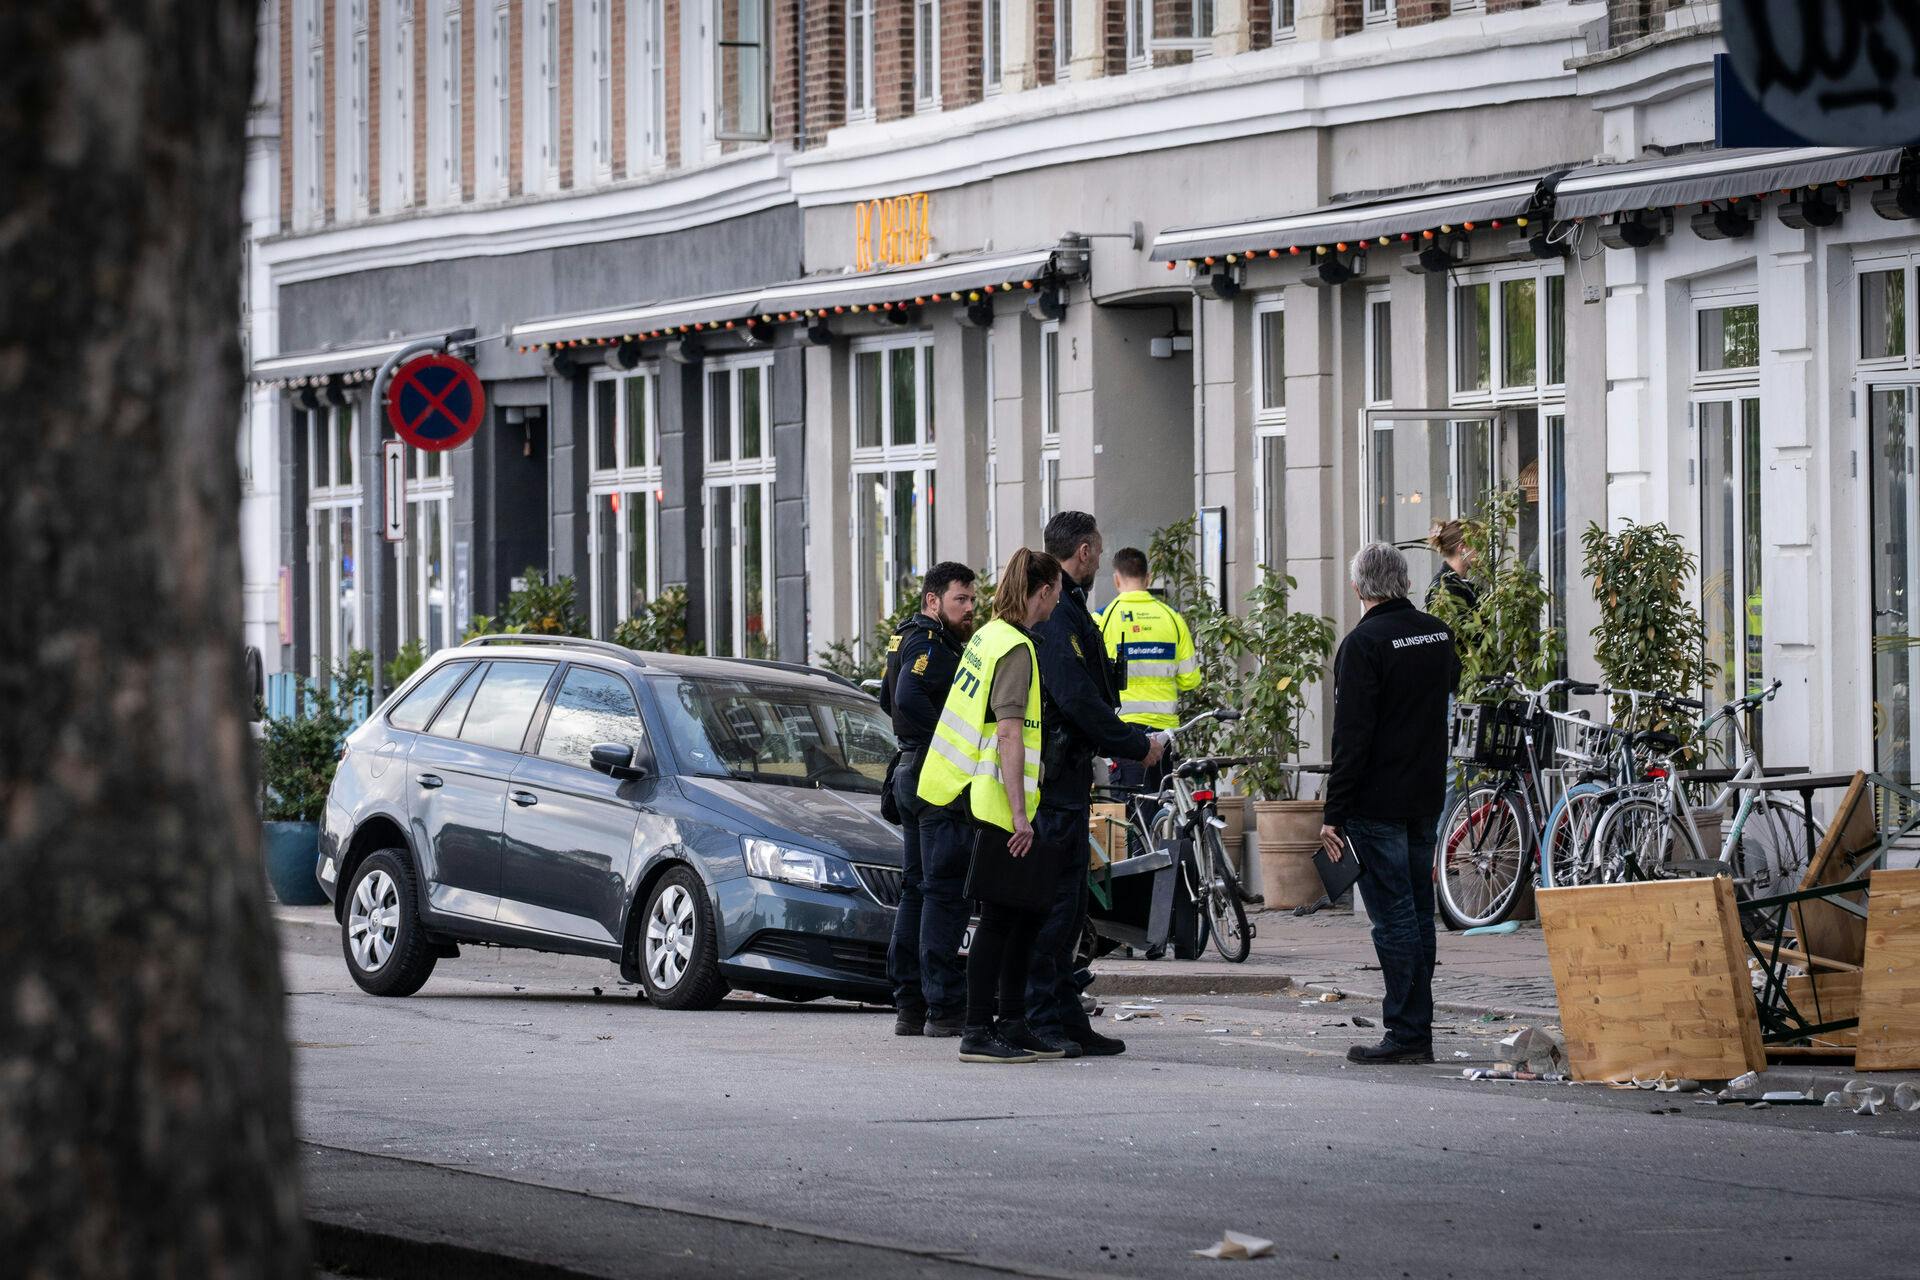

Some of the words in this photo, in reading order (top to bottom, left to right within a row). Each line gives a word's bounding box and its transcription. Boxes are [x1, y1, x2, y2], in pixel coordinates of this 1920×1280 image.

[856, 192, 929, 273] ROBERTA
[1127, 646, 1166, 655] Behandler
[1024, 718, 1042, 729] OLI
